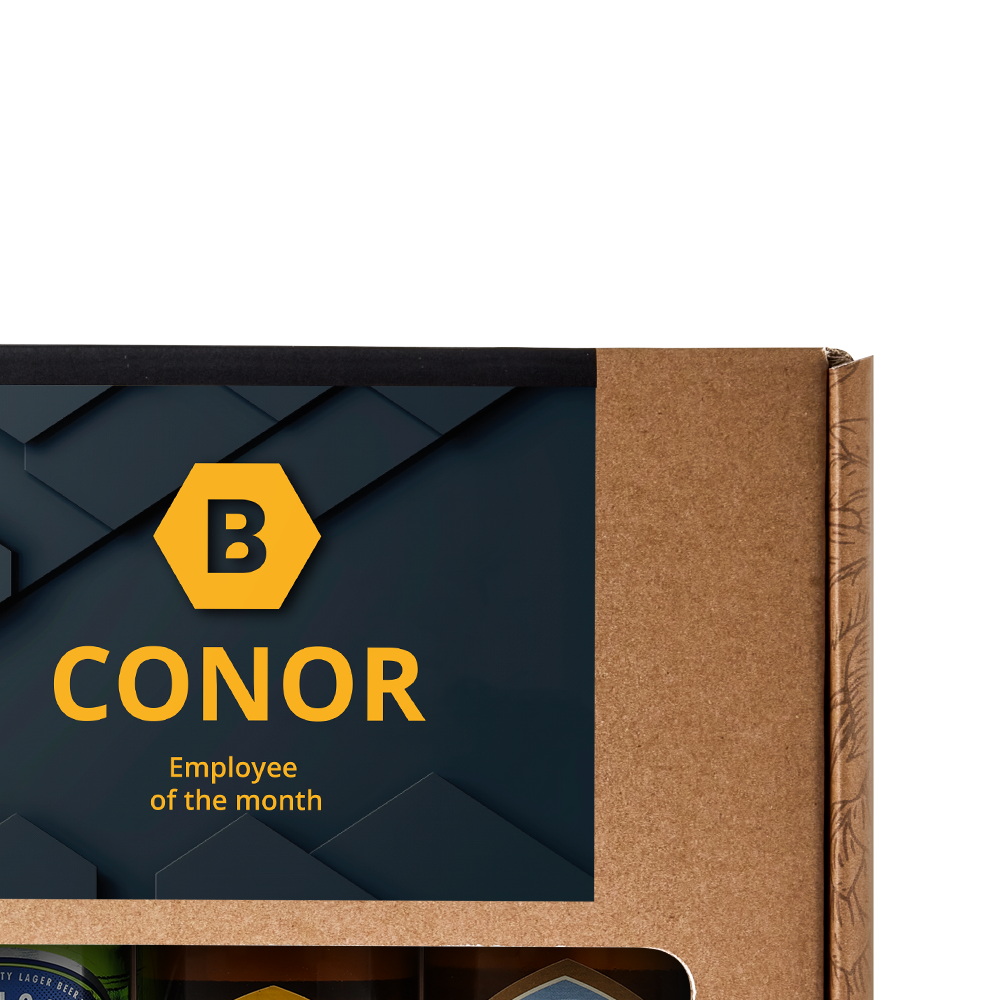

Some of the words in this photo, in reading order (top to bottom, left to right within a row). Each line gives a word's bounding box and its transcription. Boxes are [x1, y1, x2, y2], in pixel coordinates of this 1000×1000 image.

[207, 498, 267, 574] B
[53, 645, 426, 722] CONOR
[169, 755, 298, 784] Employee
[150, 788, 178, 811] of
[183, 788, 227, 811] the
[236, 788, 323, 811] month
[18, 974, 53, 987] LAGER
[56, 981, 80, 1000] BEER
